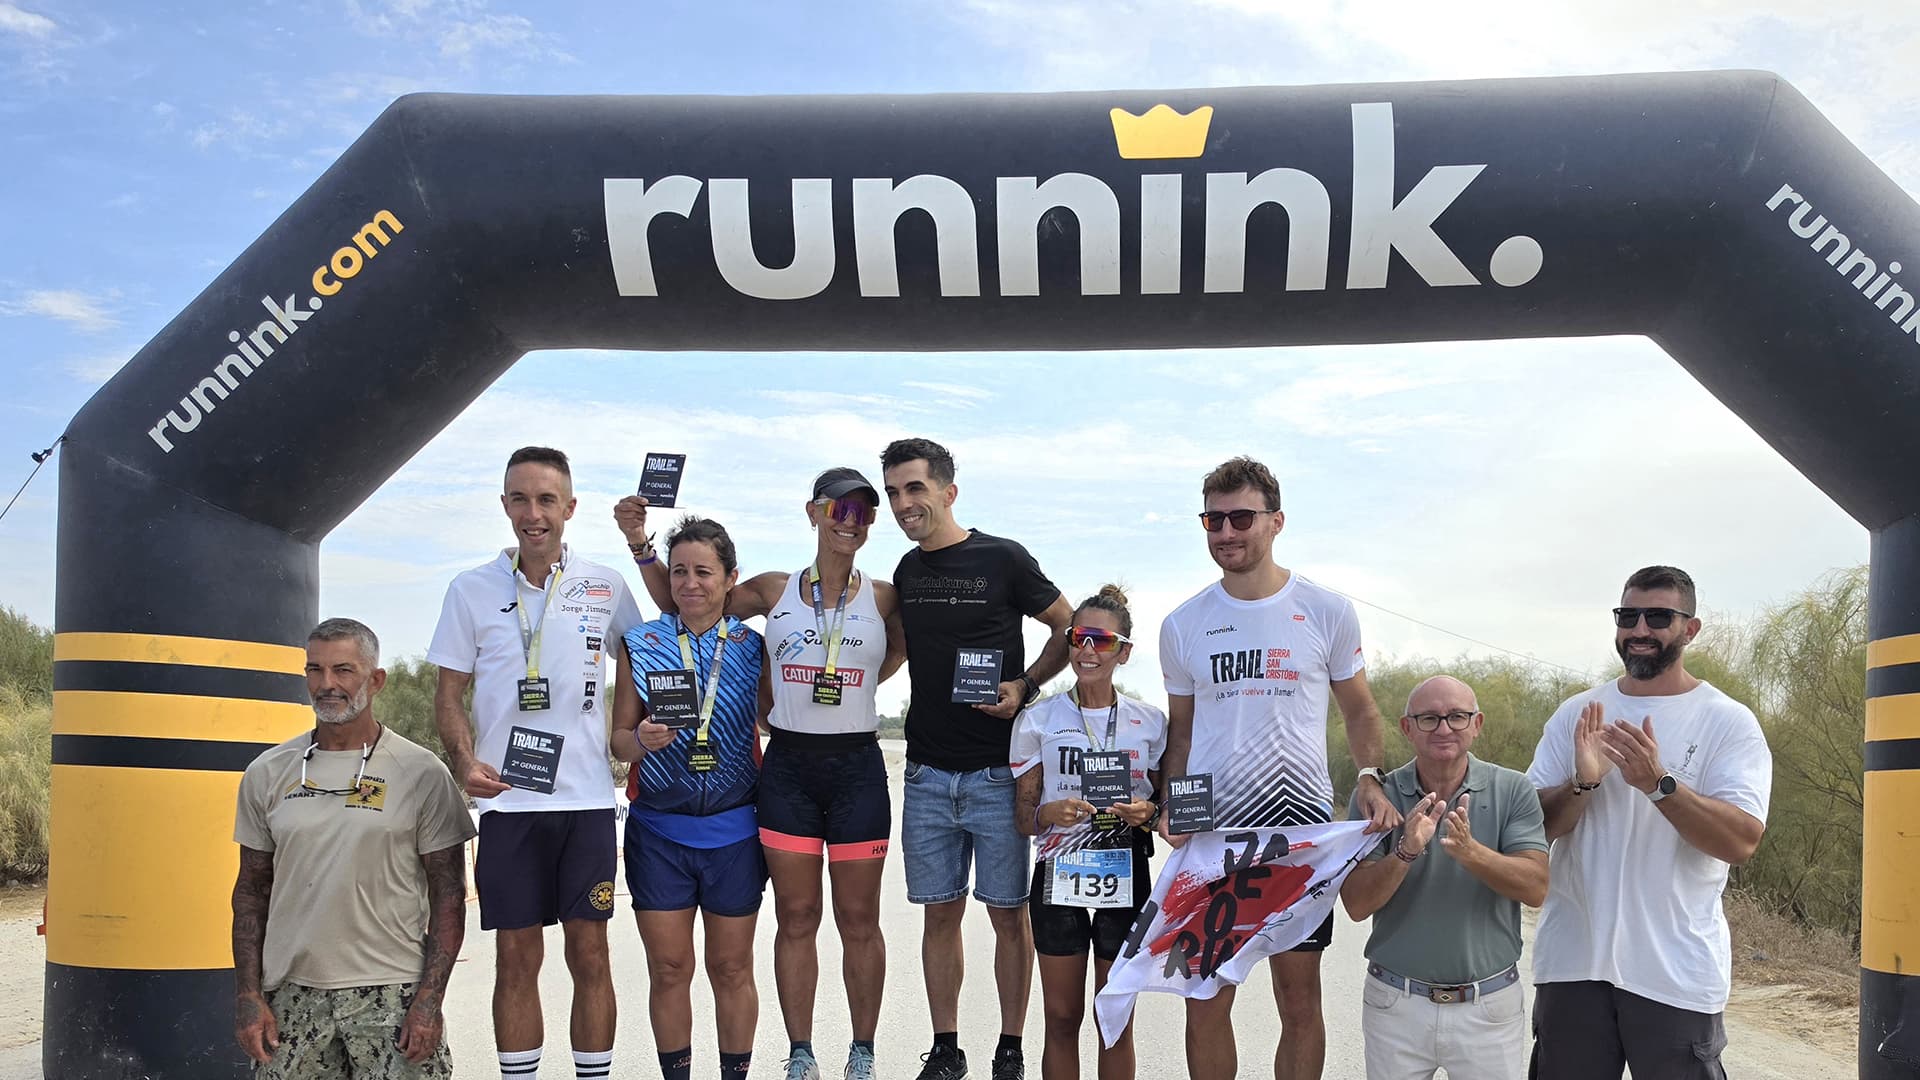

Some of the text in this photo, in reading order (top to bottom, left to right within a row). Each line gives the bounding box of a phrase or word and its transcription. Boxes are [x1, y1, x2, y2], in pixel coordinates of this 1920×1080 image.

[603, 102, 1543, 299] runnink.
[148, 209, 405, 454] runnink.com
[646, 457, 667, 471] TRAIL
[561, 605, 583, 614] Jorge
[1206, 624, 1238, 636] runnink.
[959, 652, 982, 667] TRAIL
[1267, 648, 1291, 658] SIERRA
[1209, 649, 1264, 684] TRAIL
[1266, 659, 1280, 668] SAN
[648, 676, 675, 690] TRAIL
[1240, 687, 1265, 696] vuelve
[512, 731, 539, 750] TRAIL
[520, 762, 550, 773] GENERAL
[1083, 757, 1109, 772] TRAIL
[1170, 780, 1194, 796] TRAIL
[1182, 805, 1207, 814] GENERAL
[1069, 872, 1119, 898] 139
